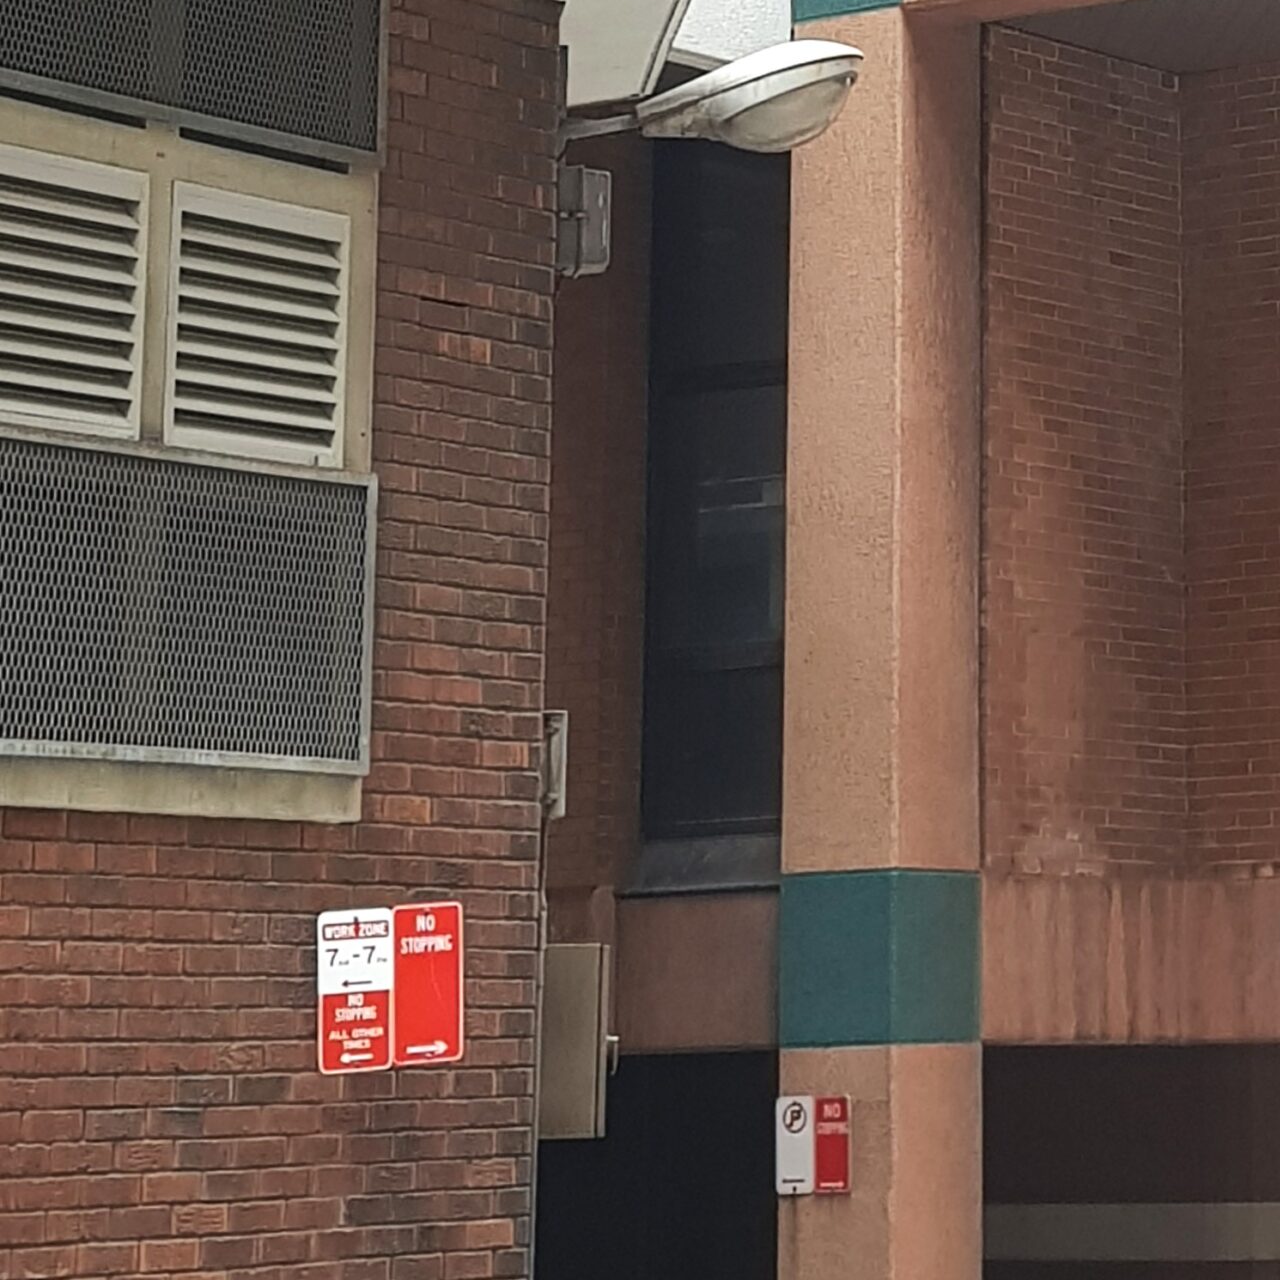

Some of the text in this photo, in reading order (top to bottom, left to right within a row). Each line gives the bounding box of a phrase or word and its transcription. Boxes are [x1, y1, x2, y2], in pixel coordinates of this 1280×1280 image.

[325, 922, 387, 939] WORK ZONE
[416, 914, 436, 932] NO
[400, 934, 453, 955] STOPPING
[347, 993, 364, 1007] NO
[335, 1005, 377, 1023] STOPPING
[328, 1029, 350, 1041] ALL
[823, 1103, 842, 1119] NO
